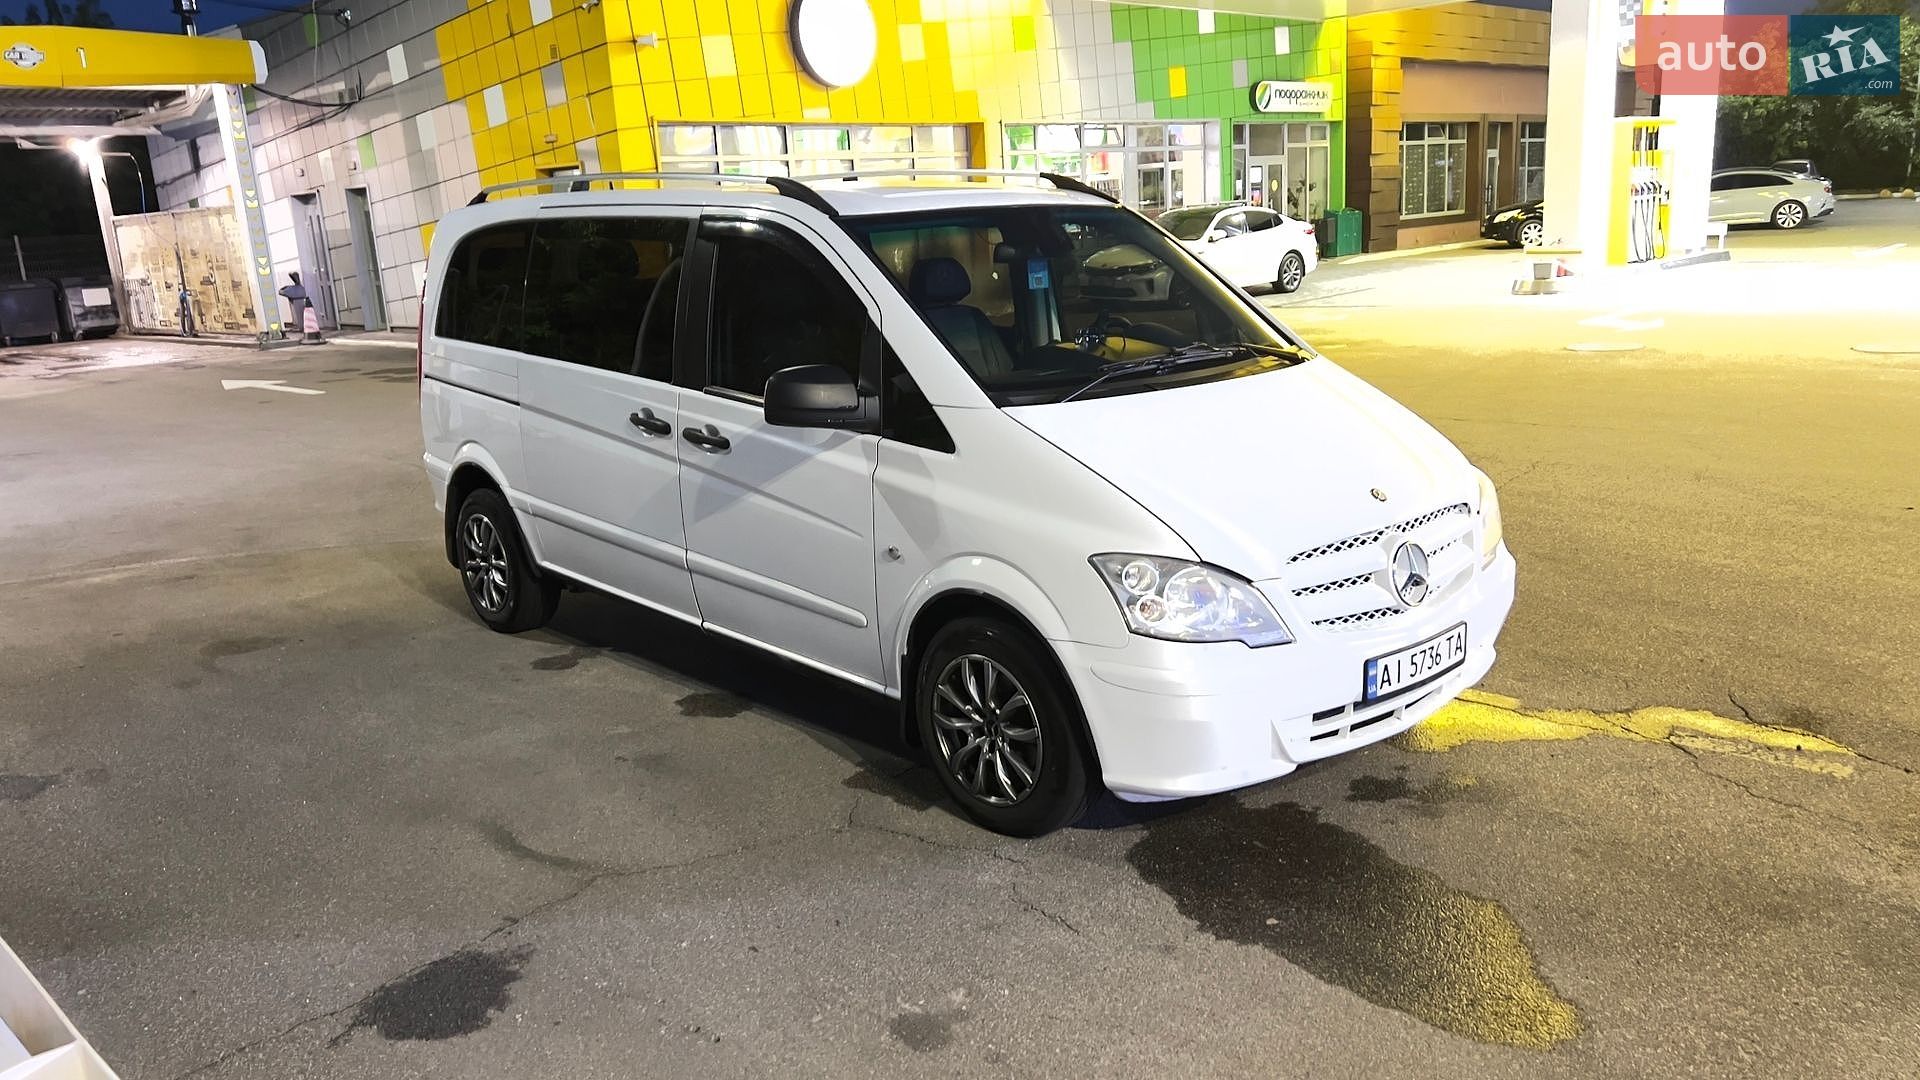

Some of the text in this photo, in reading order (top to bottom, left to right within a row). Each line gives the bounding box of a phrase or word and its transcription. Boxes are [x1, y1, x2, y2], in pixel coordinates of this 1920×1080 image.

[76, 47, 87, 69] 1
[1380, 631, 1463, 690] AI 5736 TA
